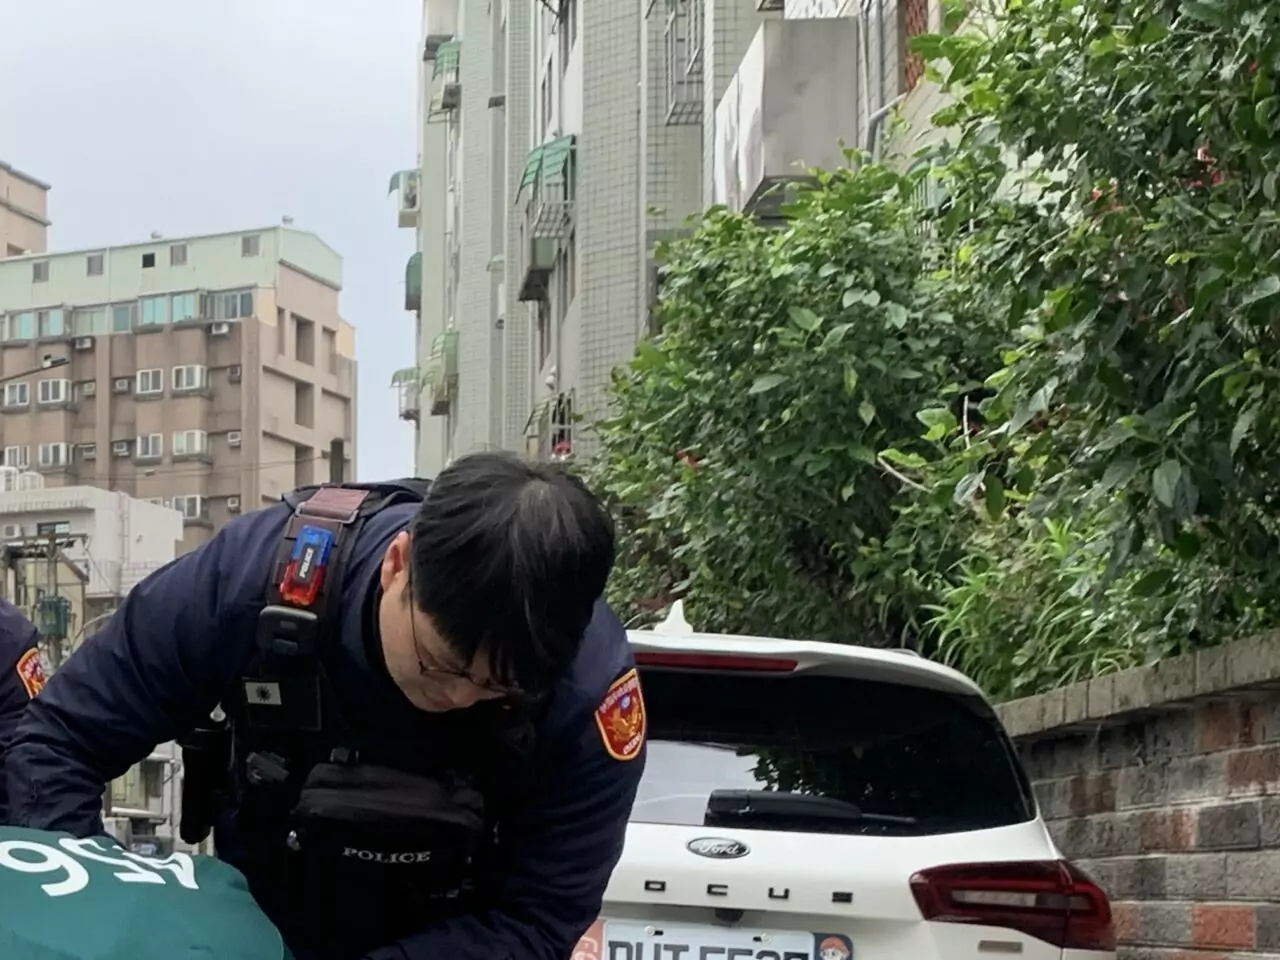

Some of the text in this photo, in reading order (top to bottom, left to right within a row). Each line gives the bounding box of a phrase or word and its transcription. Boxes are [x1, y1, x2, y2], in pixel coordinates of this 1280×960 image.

[299, 547, 314, 579] POLICE
[342, 846, 432, 864] POLICE
[644, 879, 854, 904] OCUS
